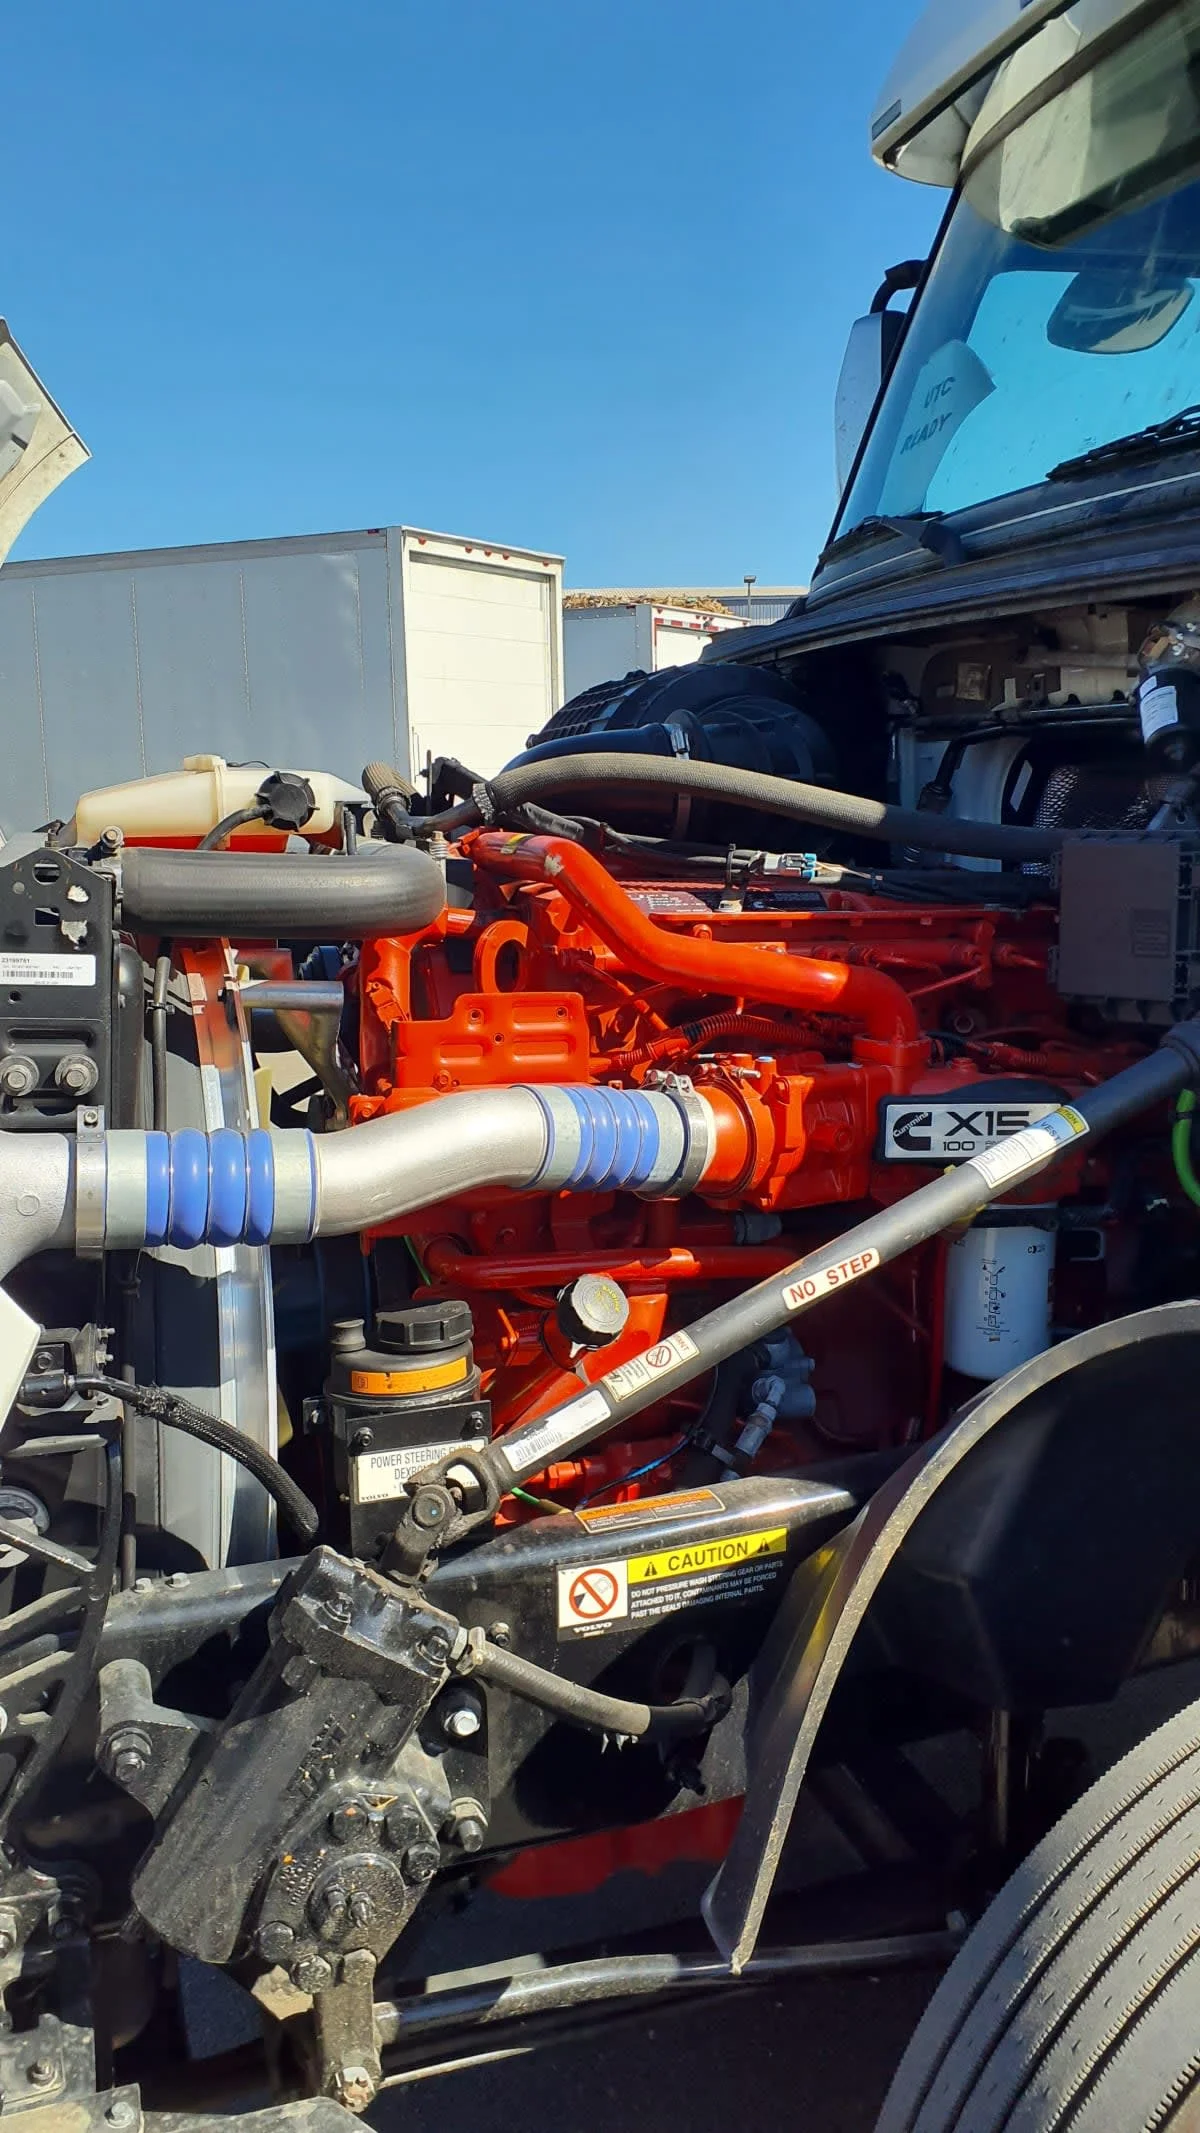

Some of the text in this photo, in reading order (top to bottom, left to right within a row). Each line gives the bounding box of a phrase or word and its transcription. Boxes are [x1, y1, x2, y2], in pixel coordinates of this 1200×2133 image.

[900, 411, 952, 455] READY
[893, 1111, 929, 1138] Cummins
[944, 1110, 1030, 1137] X15
[943, 1140, 976, 1152] 100
[789, 1252, 873, 1303] NO STEP
[370, 1453, 402, 1469] POWER
[404, 1447, 447, 1465] STEERING
[668, 1541, 748, 1571] CAUTION
[630, 1560, 783, 1599] DO NOT PRESSURE WASH STEERING GEAR OR PARTS
[630, 1596, 665, 1609] ATTACHED
[665, 1594, 674, 1602] TO
[730, 1578, 743, 1587] MAY
[743, 1576, 752, 1585] BE
[753, 1571, 777, 1582] FORCED
[630, 1608, 647, 1620] PAST
[648, 1606, 661, 1616] THE
[661, 1602, 682, 1613] SEALS
[714, 1590, 742, 1601] INTERNAL
[573, 1621, 613, 1634] VOLVO
